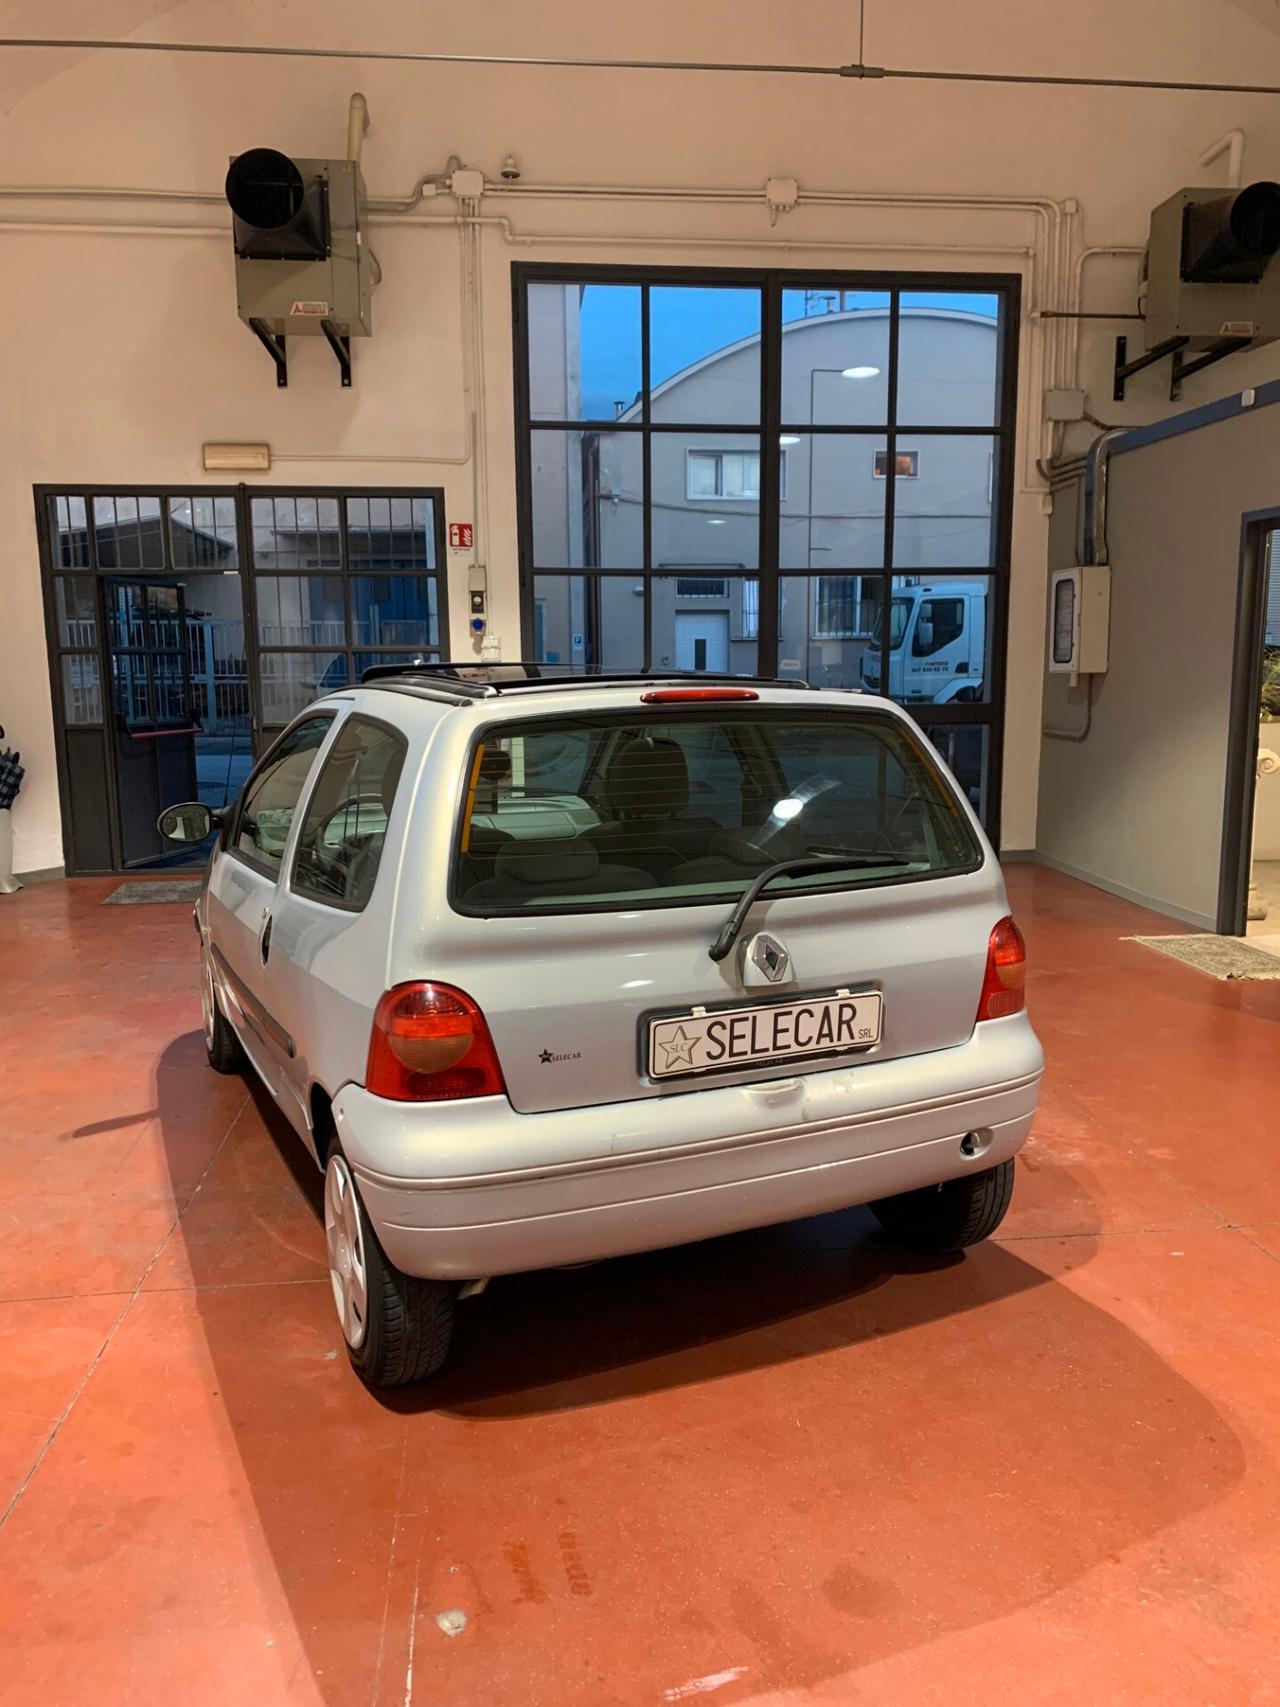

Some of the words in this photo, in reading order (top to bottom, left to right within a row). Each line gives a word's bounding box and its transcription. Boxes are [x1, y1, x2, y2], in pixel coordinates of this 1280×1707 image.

[706, 1003, 857, 1061] SELECAR
[858, 1027, 874, 1039] SRL
[670, 1042, 688, 1054] SLC
[551, 1051, 582, 1062] SELECAR
